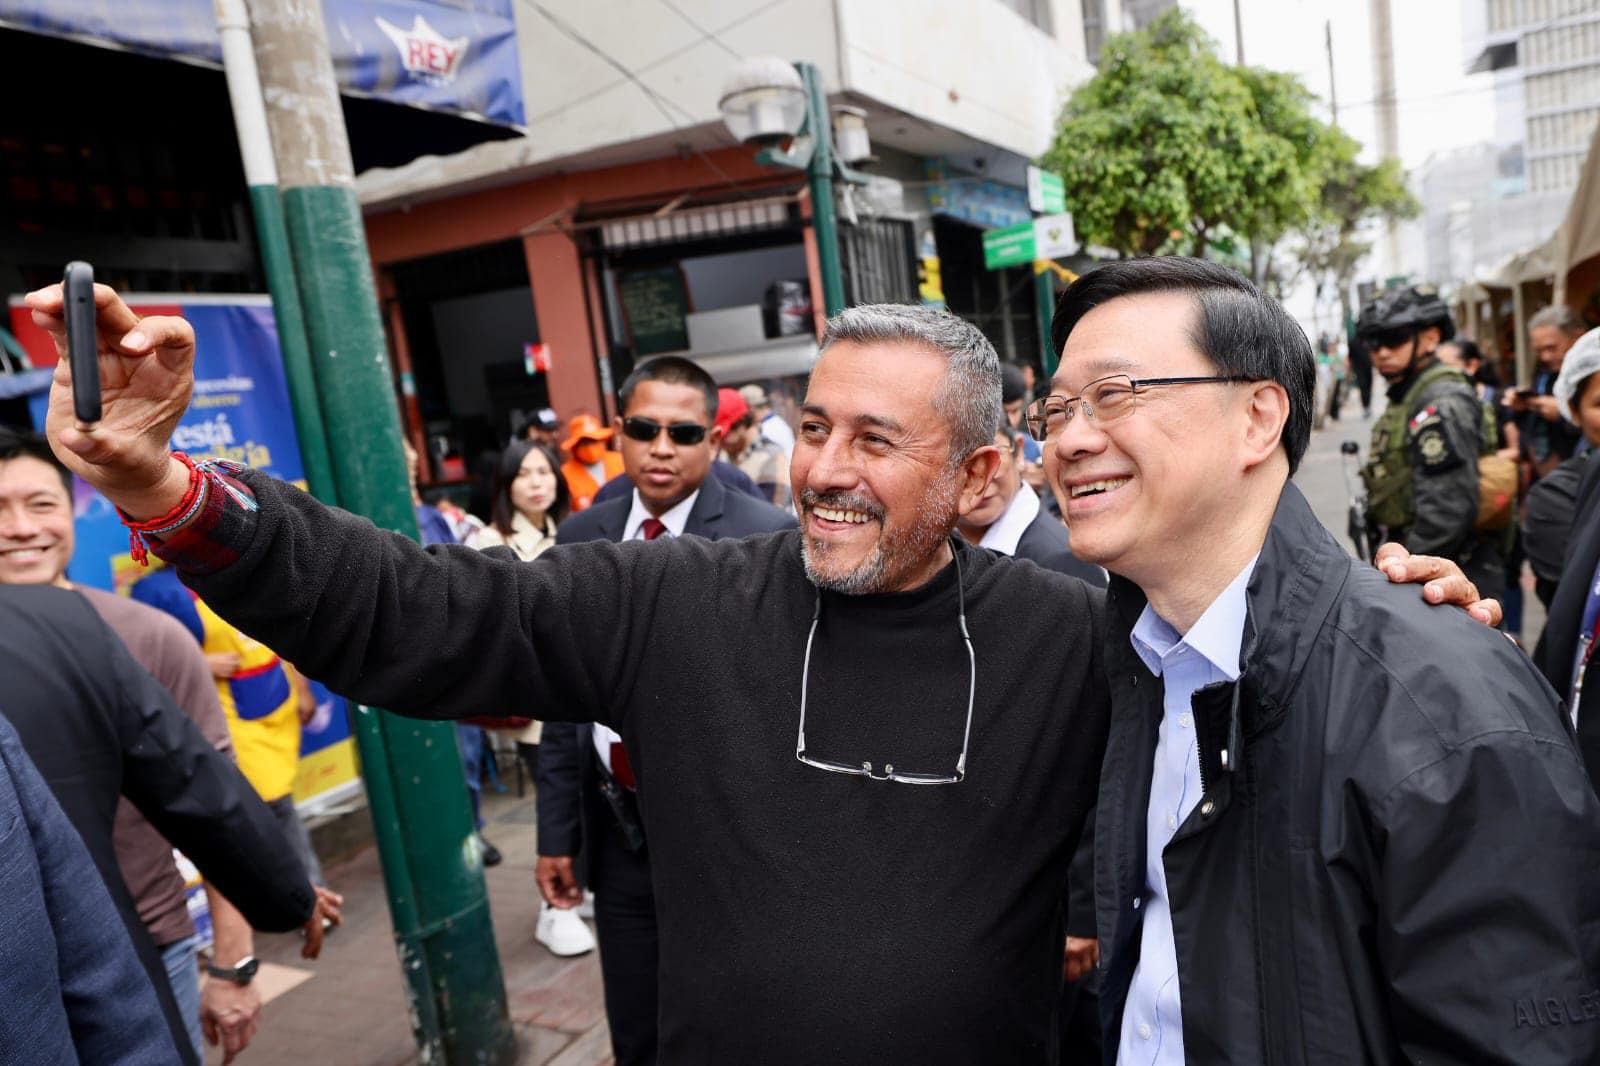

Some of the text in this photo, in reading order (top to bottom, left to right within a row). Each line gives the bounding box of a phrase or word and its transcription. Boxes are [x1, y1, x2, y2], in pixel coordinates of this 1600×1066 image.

[406, 38, 457, 73] REY
[172, 412, 236, 449] está
[1513, 993, 1599, 1028] AIGLE
